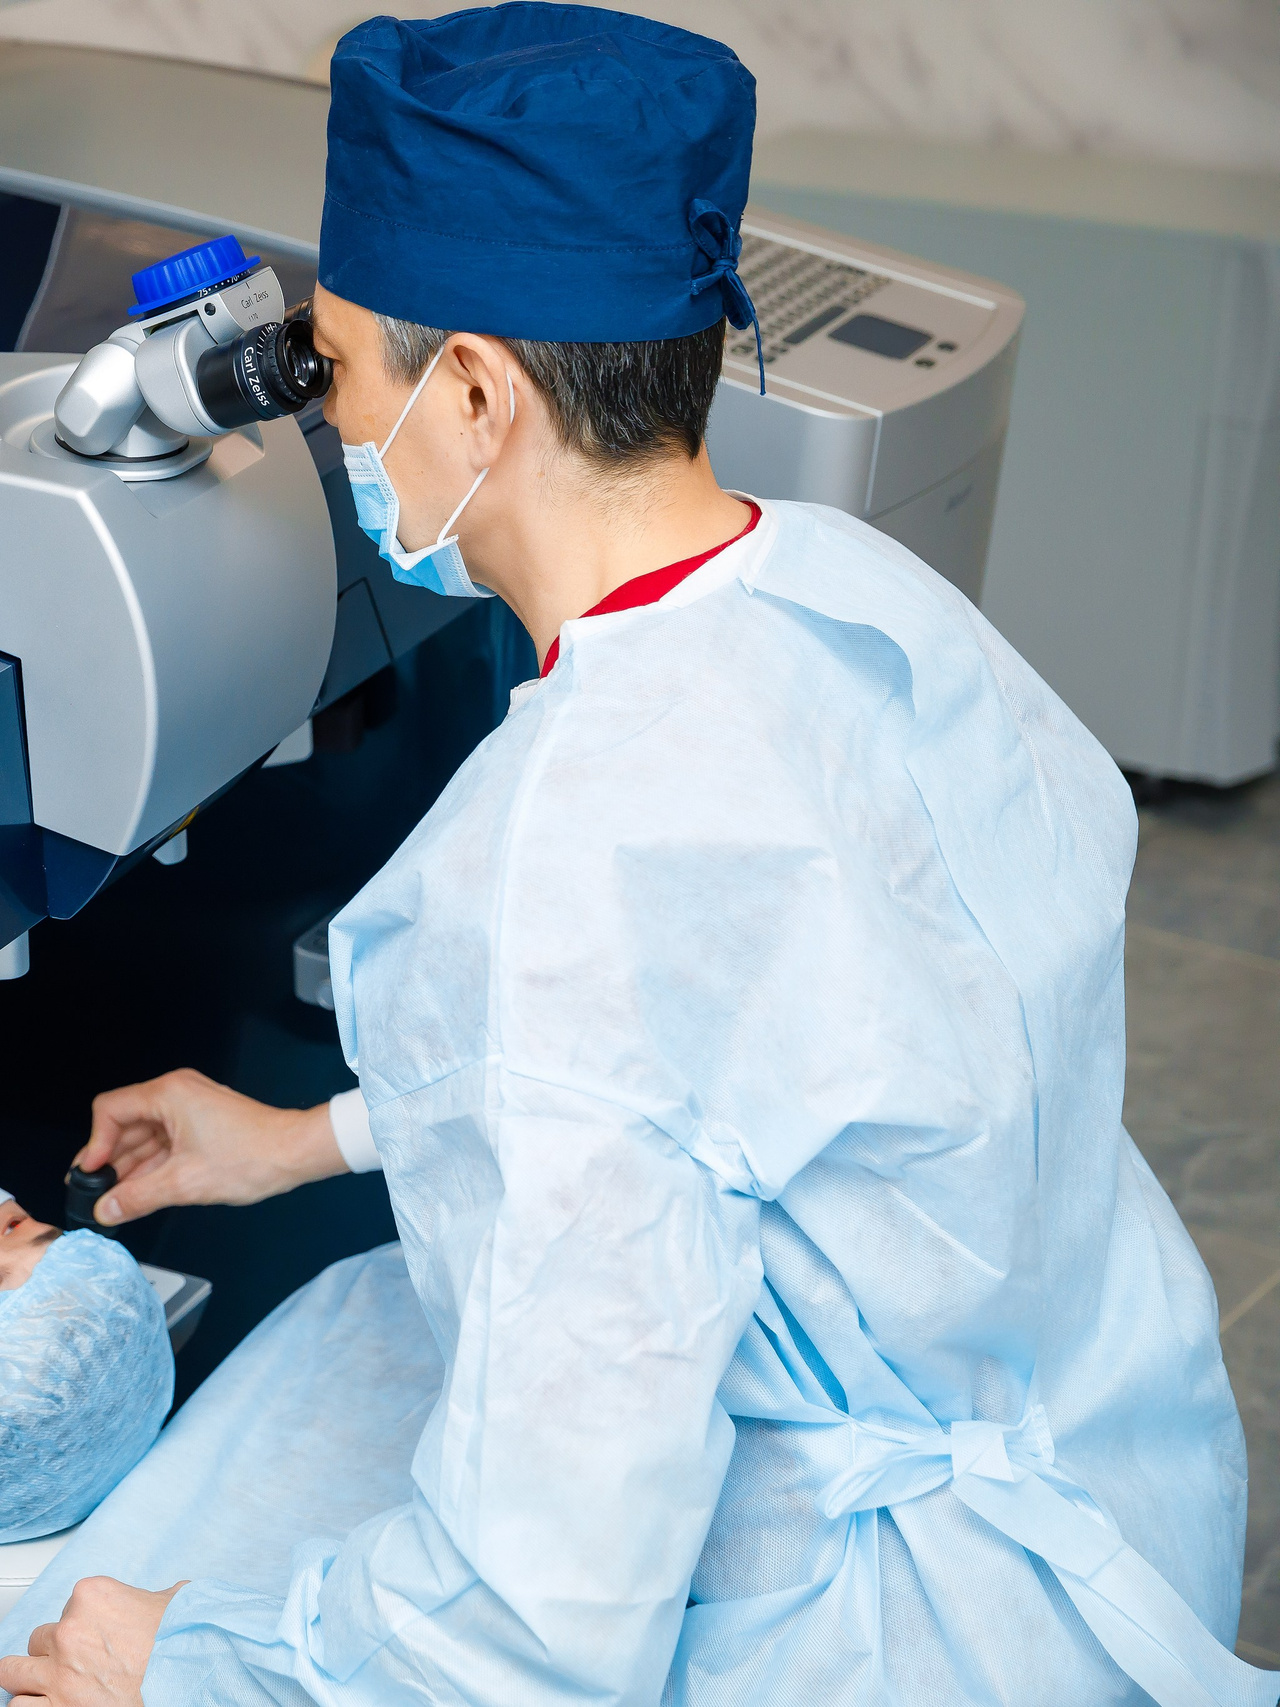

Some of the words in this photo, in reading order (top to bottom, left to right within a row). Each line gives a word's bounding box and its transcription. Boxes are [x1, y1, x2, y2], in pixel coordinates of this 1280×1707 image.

[197, 287, 208, 297] 75
[241, 295, 254, 309] Carl
[253, 290, 269, 303] Zeiss
[244, 346, 257, 373] Carl
[248, 375, 270, 407] Zeiss
